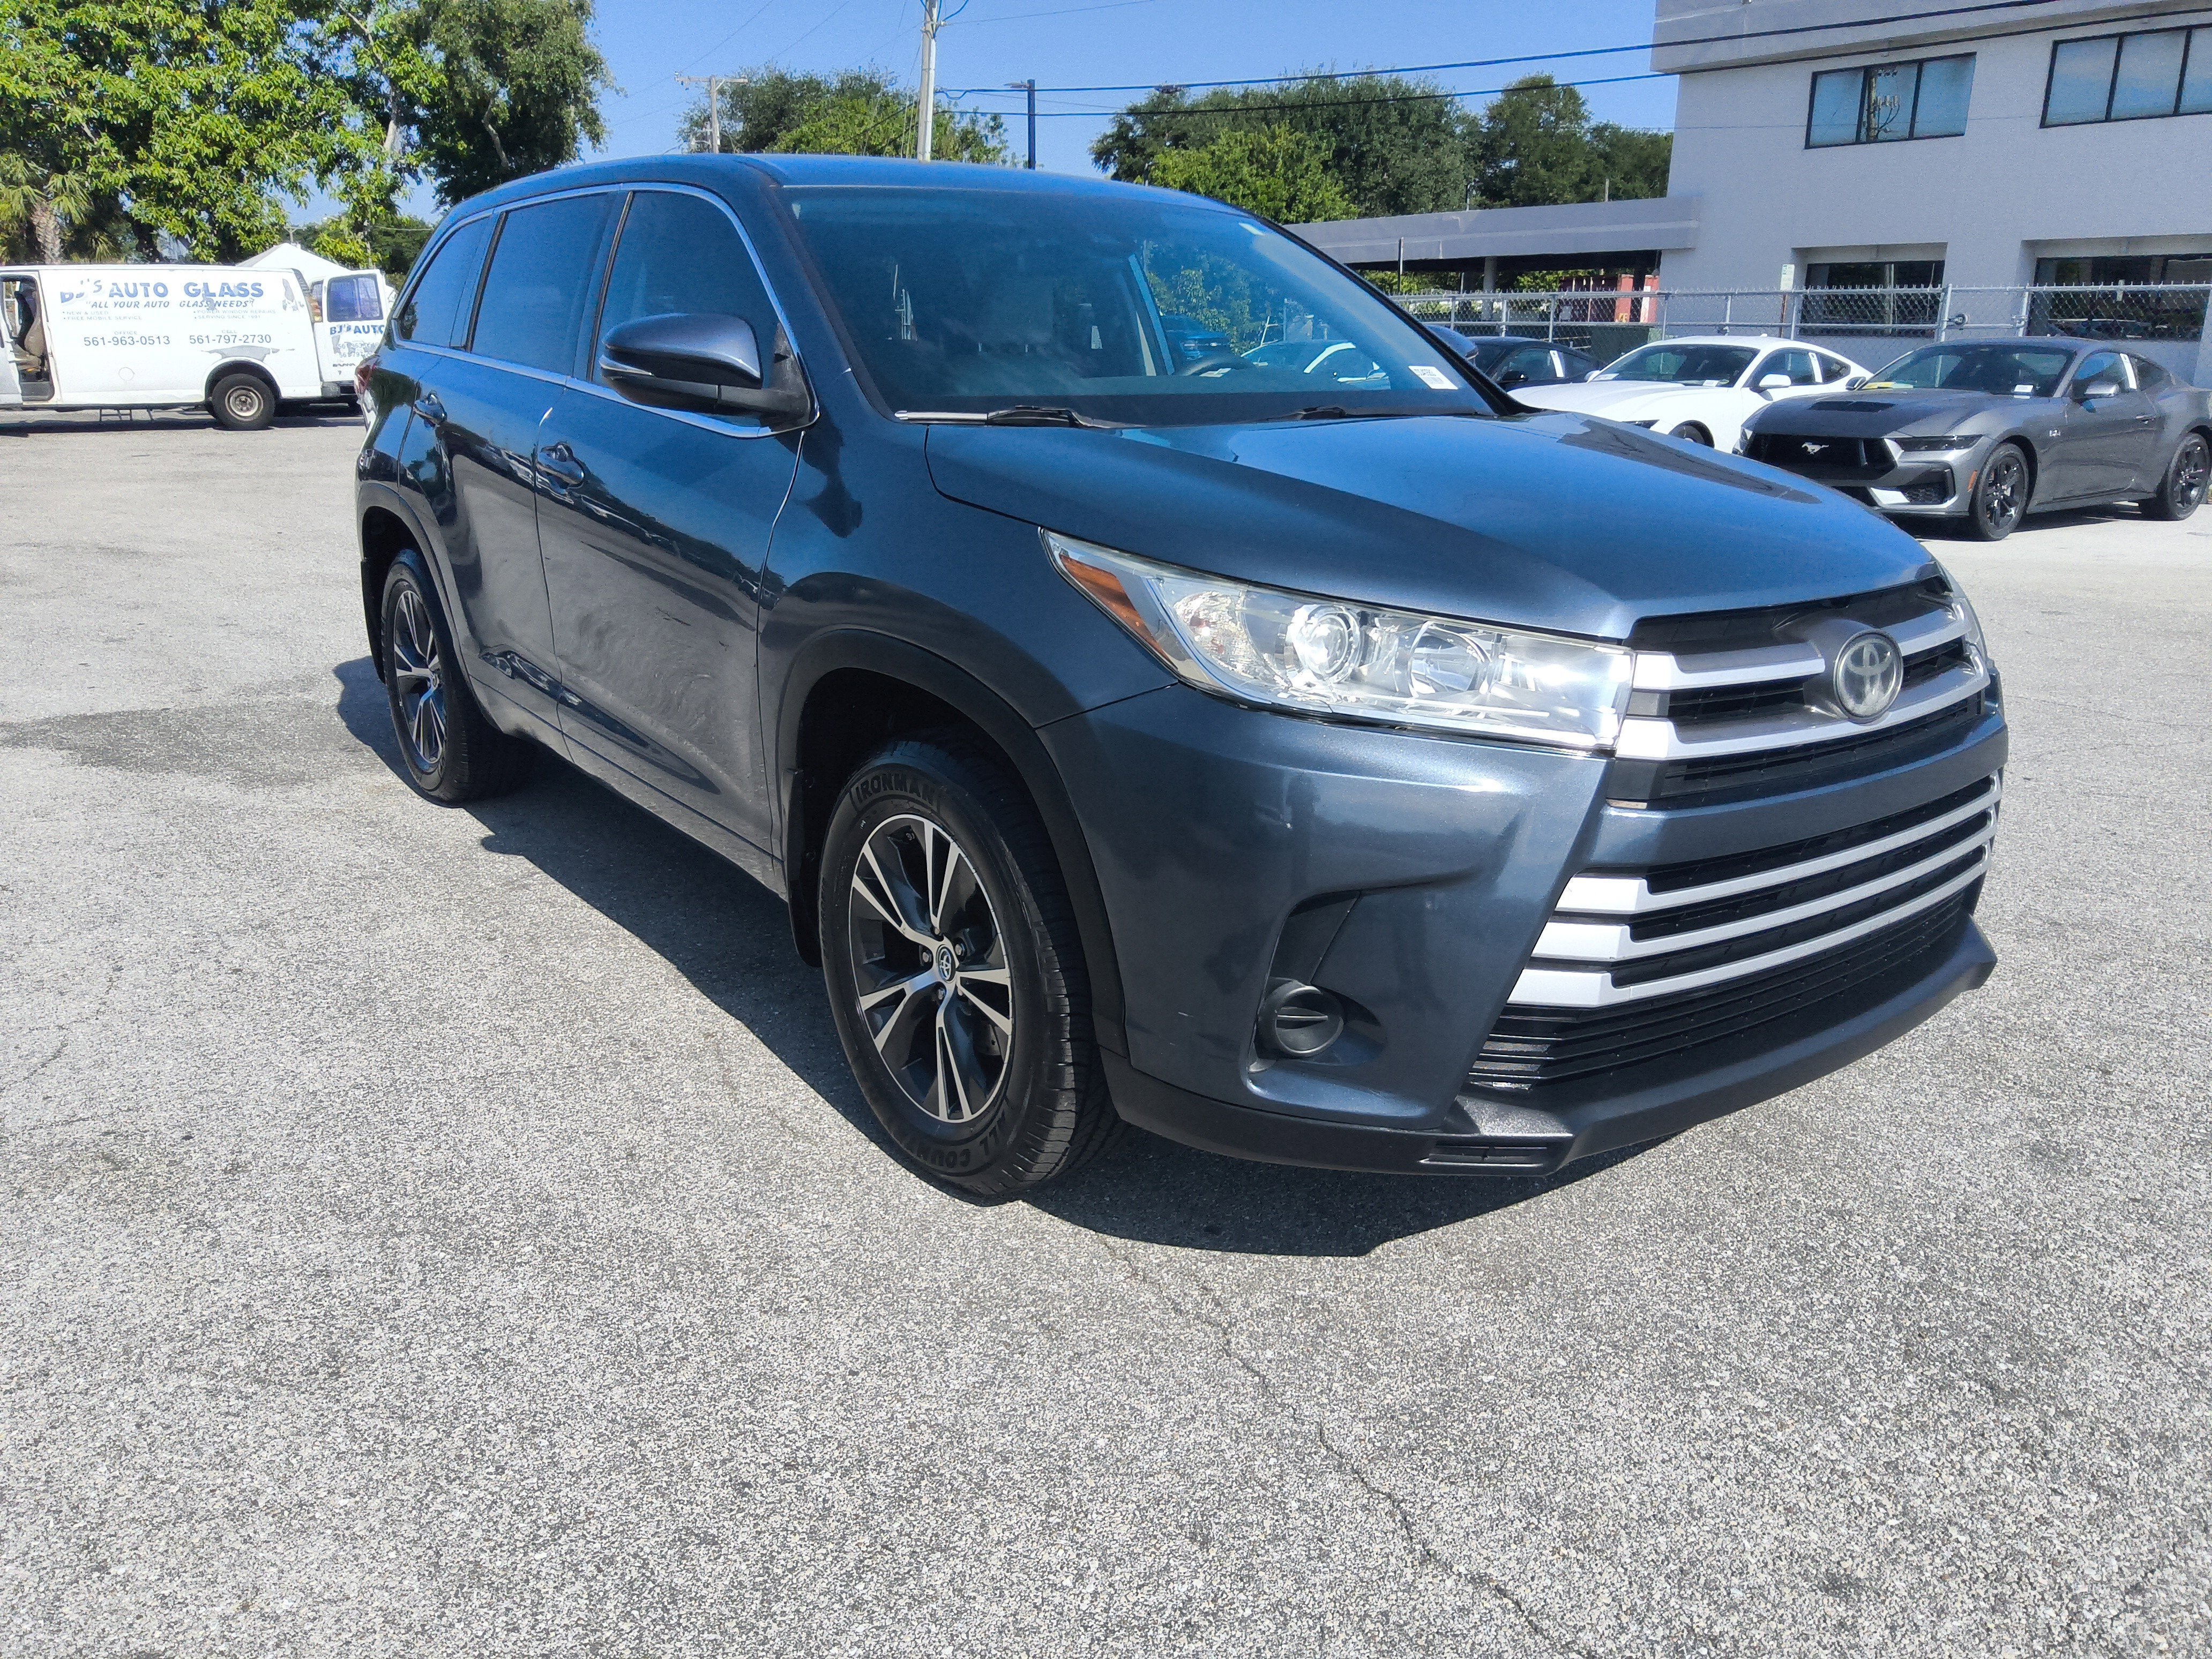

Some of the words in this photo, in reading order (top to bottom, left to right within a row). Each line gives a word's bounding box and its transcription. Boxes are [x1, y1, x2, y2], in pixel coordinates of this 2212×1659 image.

[109, 282, 169, 298] AUTO
[183, 282, 264, 298] GLASS
[114, 301, 140, 309] YOUR
[144, 301, 170, 309] AUTO
[179, 300, 211, 308] GLASS
[84, 335, 170, 346] 561-963-0513
[189, 334, 272, 344] 561-797-2730
[855, 772, 936, 805] IRONMAN
